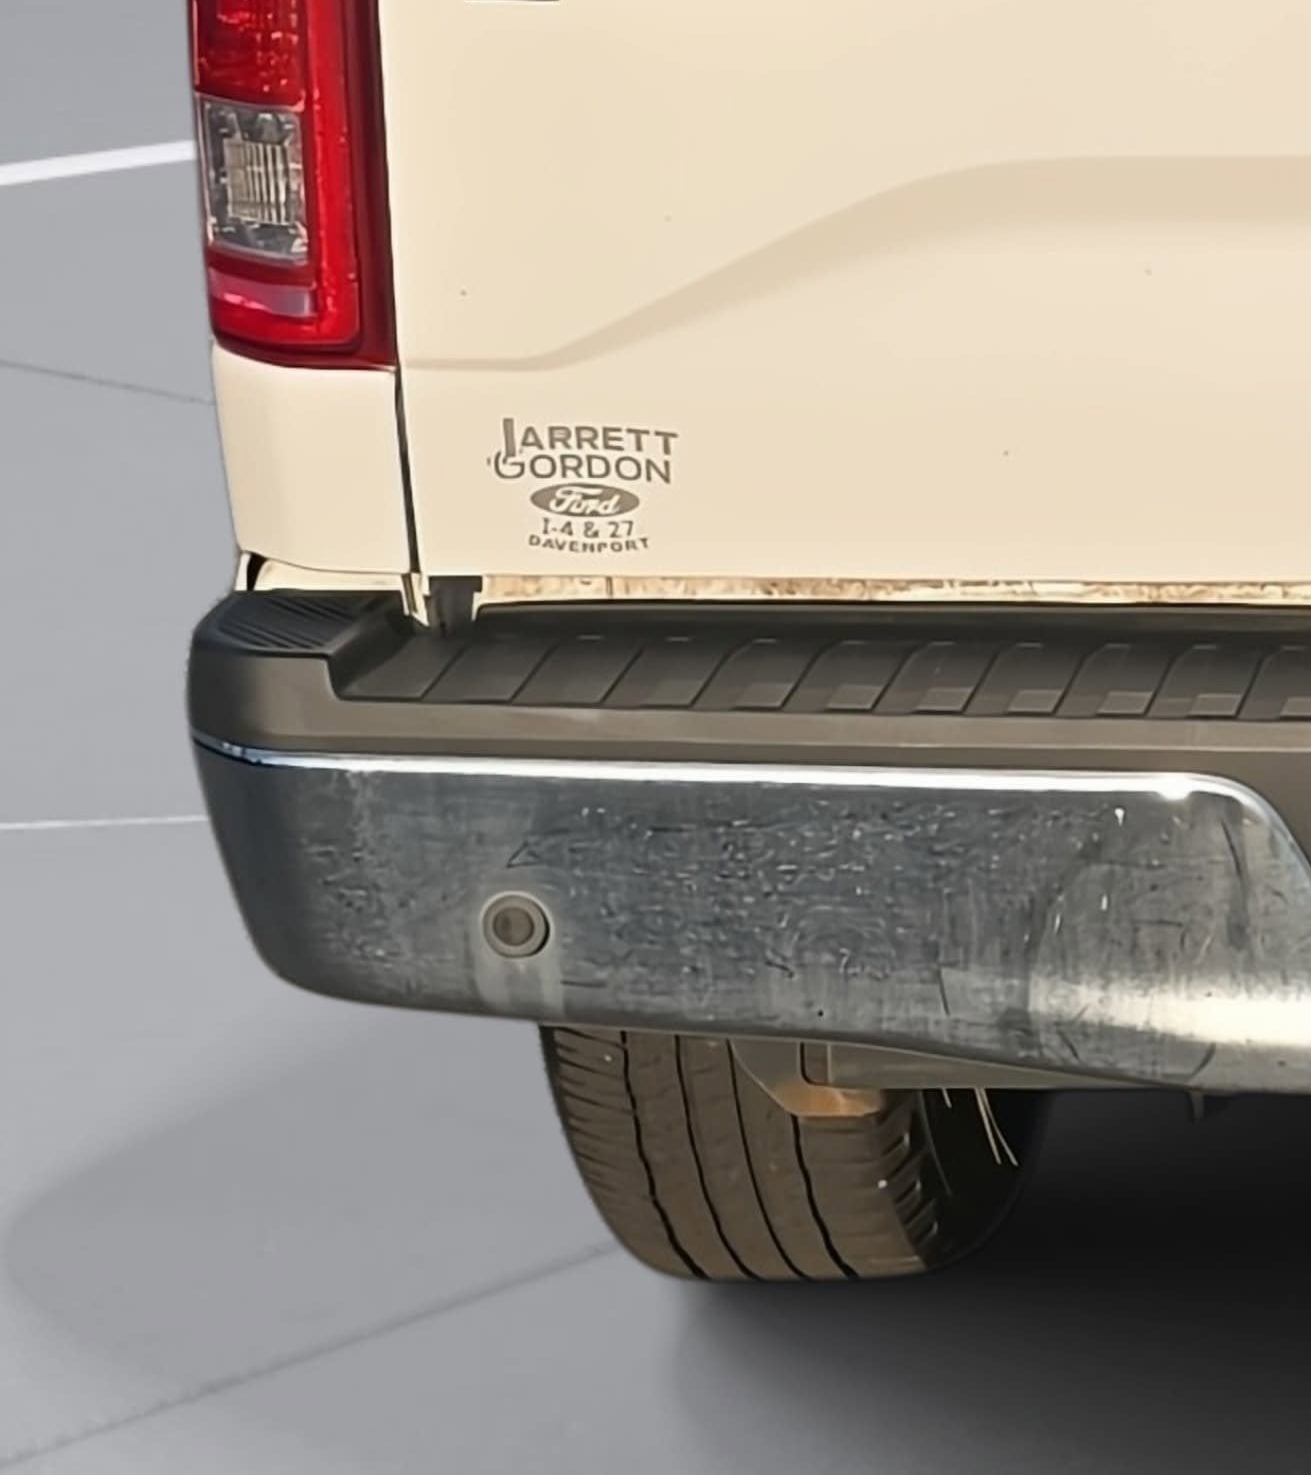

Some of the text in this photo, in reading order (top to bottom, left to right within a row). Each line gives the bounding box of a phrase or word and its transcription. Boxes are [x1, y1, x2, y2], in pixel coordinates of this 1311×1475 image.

[501, 417, 679, 457] JARRETT
[493, 451, 671, 484] GORDON
[583, 520, 600, 539] &
[607, 520, 635, 539] 27
[528, 534, 650, 554] DAVENPORT
